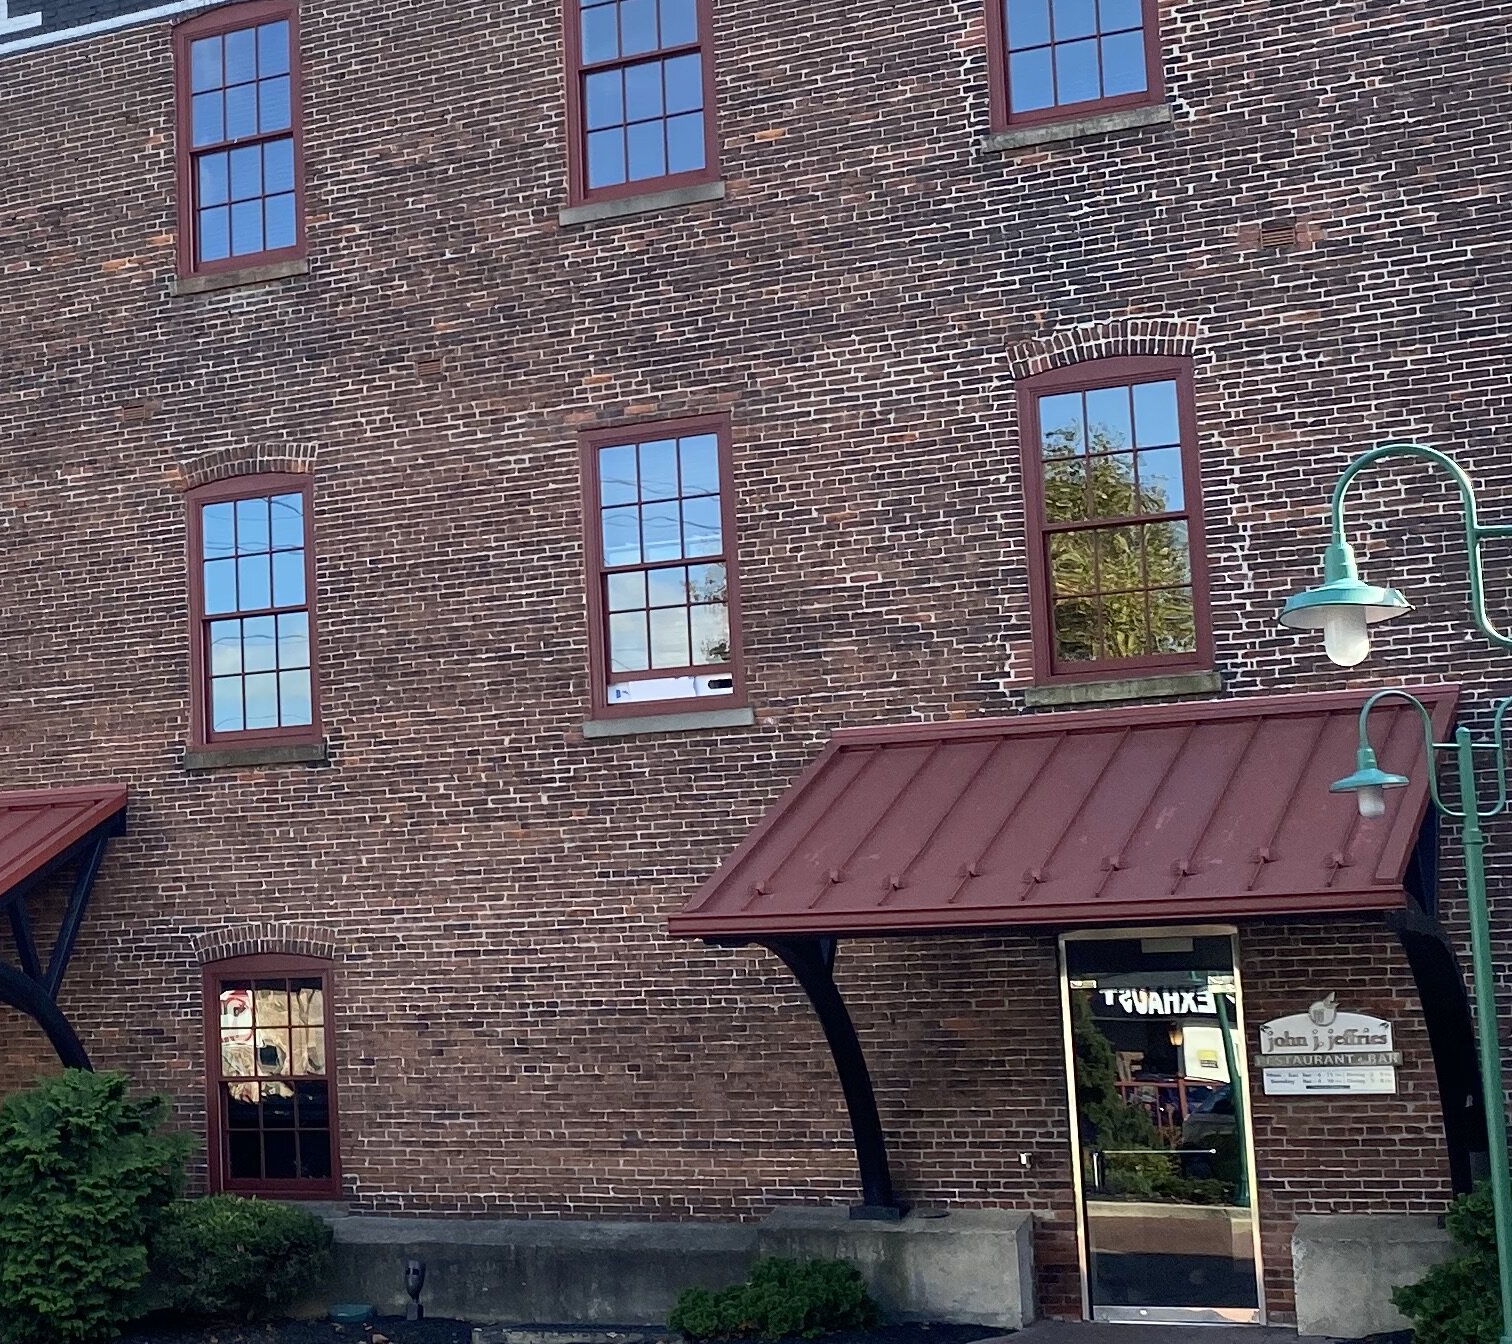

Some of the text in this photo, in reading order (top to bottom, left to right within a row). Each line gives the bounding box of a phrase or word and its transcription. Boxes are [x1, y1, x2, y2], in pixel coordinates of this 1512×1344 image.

[1266, 1030, 1308, 1052] john
[1327, 1026, 1388, 1051] jeffries
[1367, 1051, 1400, 1065] BAR
